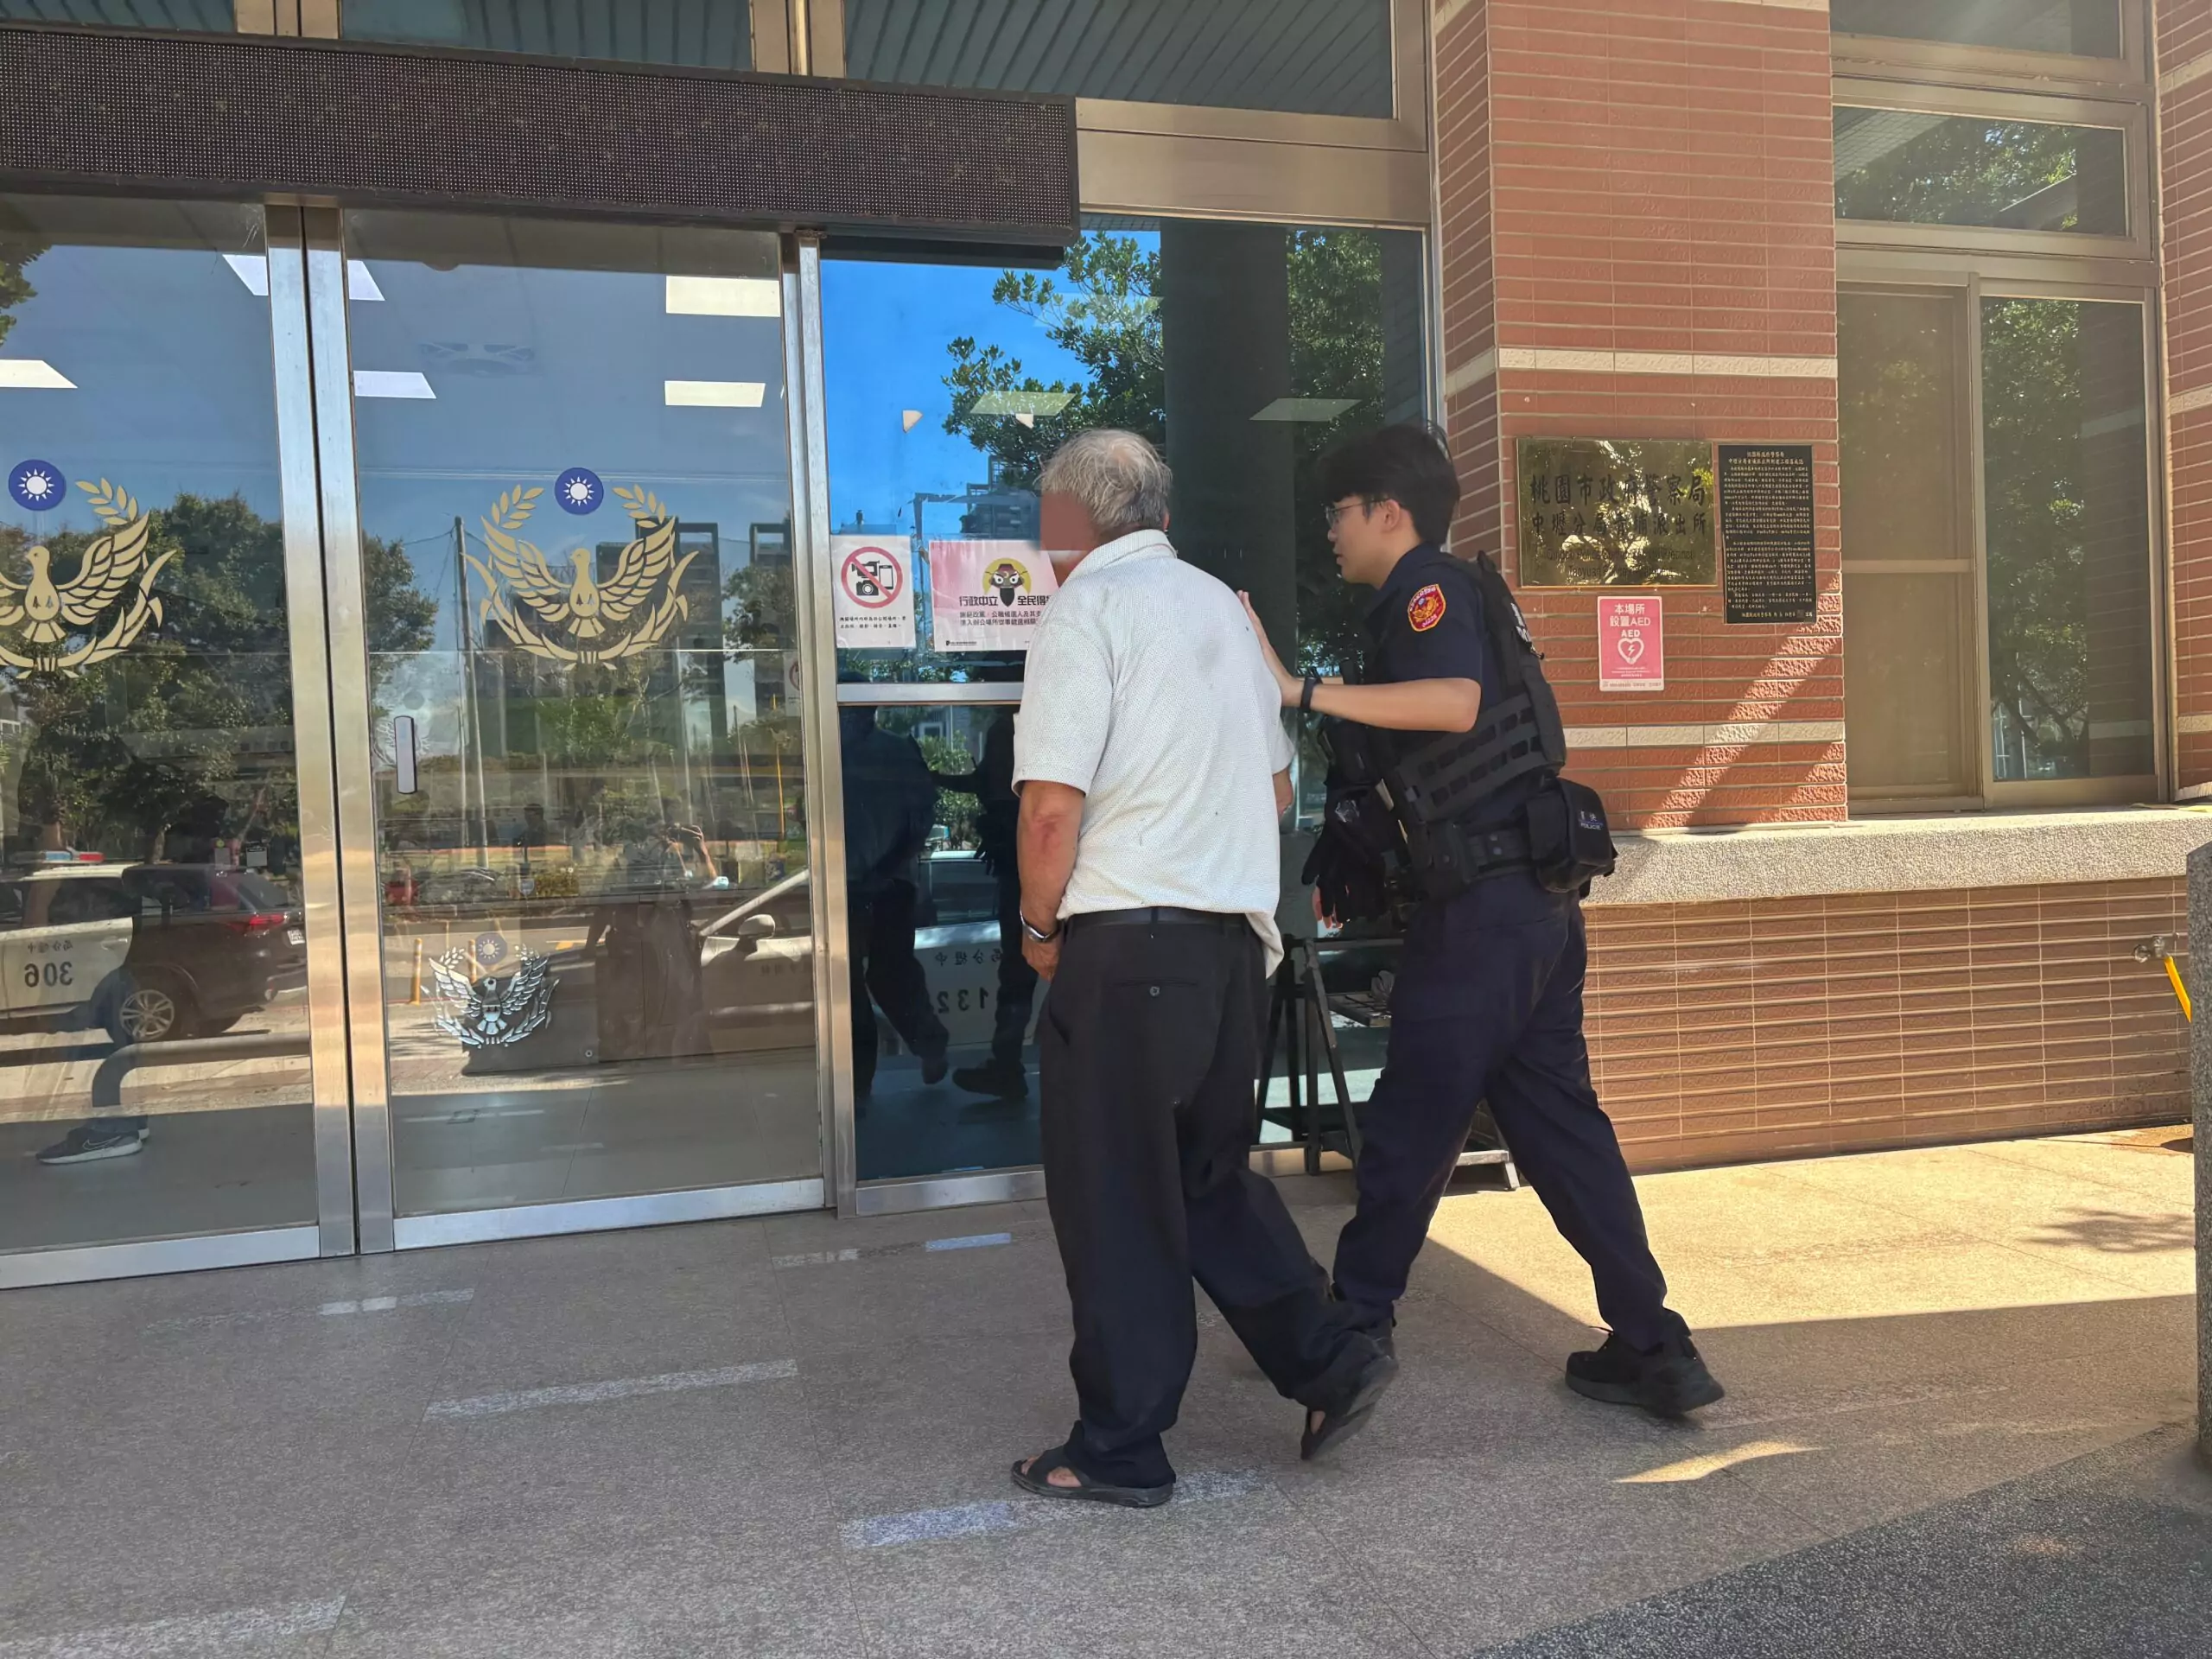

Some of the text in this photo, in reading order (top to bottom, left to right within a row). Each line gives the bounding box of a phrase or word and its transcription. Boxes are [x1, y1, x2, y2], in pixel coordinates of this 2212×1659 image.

[1529, 474, 1706, 506] 桃園市政府警察局
[1531, 512, 1707, 537] 中壢分局青埔派出所
[959, 595, 999, 607] 行政中立
[1614, 603, 1645, 614] 本場所
[1610, 615, 1651, 627] 設置AED
[1621, 629, 1641, 638] AED
